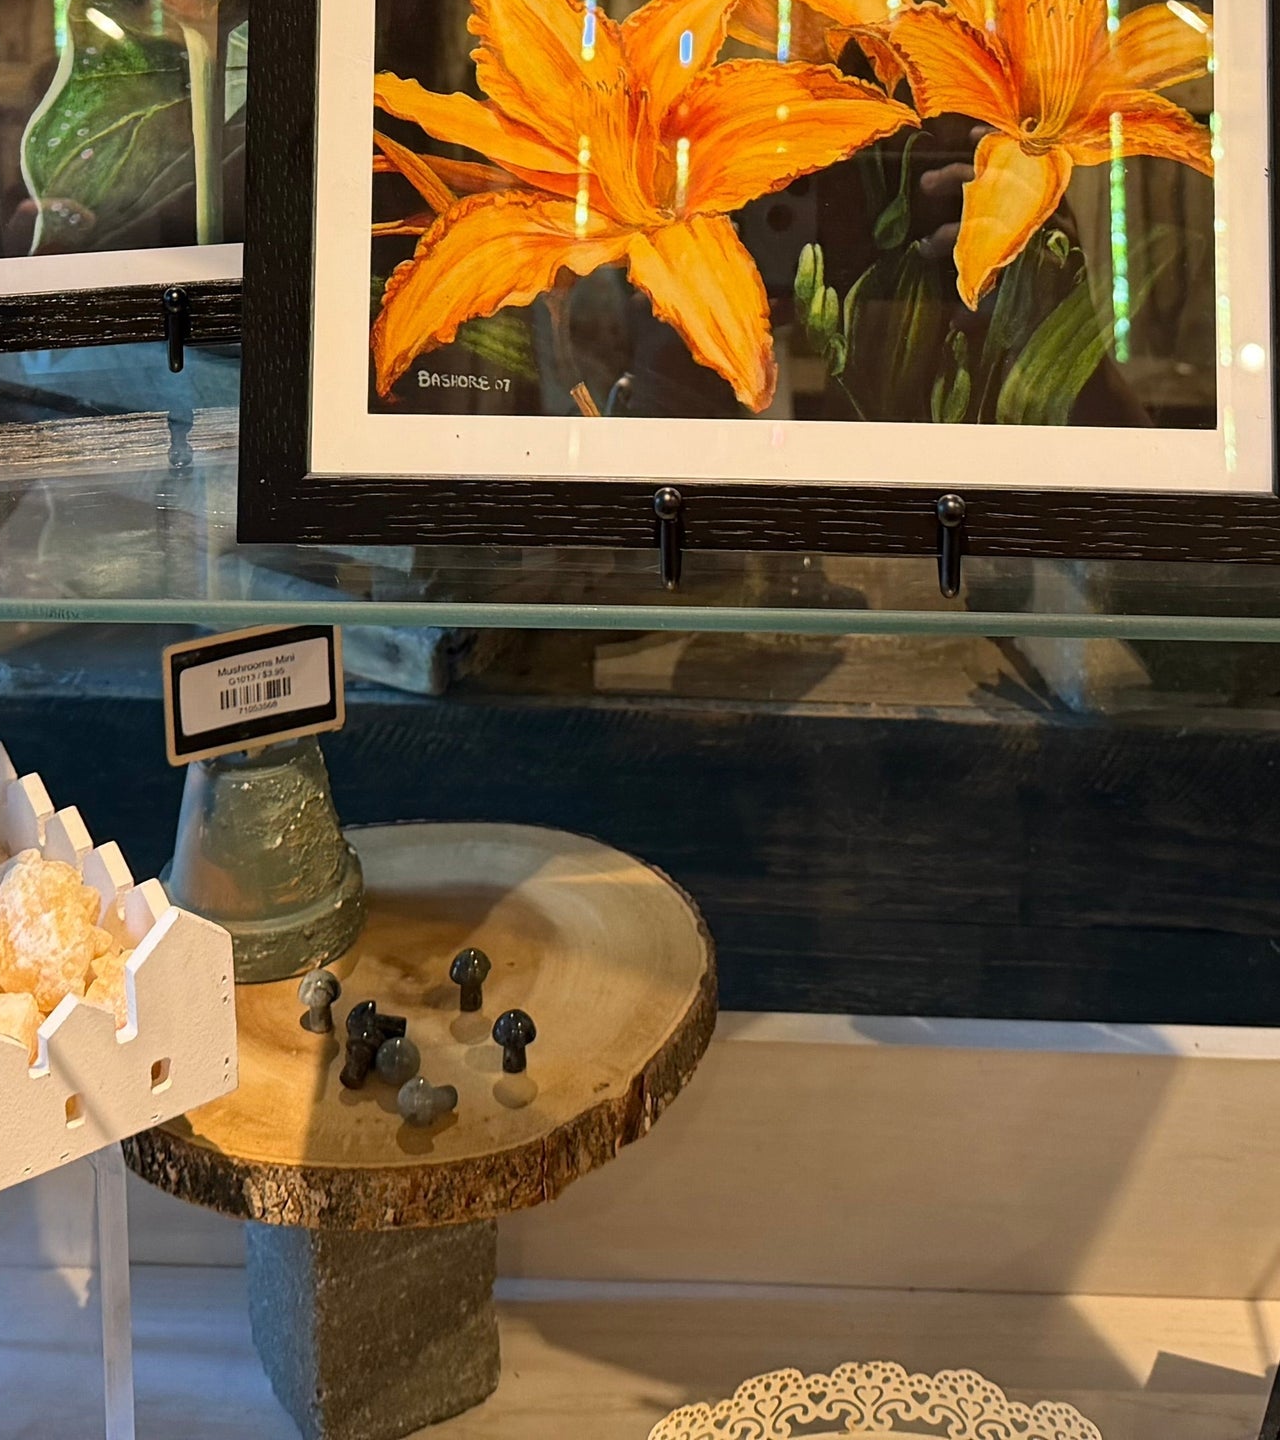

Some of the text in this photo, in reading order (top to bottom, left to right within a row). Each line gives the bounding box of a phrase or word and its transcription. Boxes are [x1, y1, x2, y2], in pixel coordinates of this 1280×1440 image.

[417, 369, 491, 391] BASHORE
[218, 654, 295, 677] Mushrooms Mini
[229, 674, 256, 685] G1013
